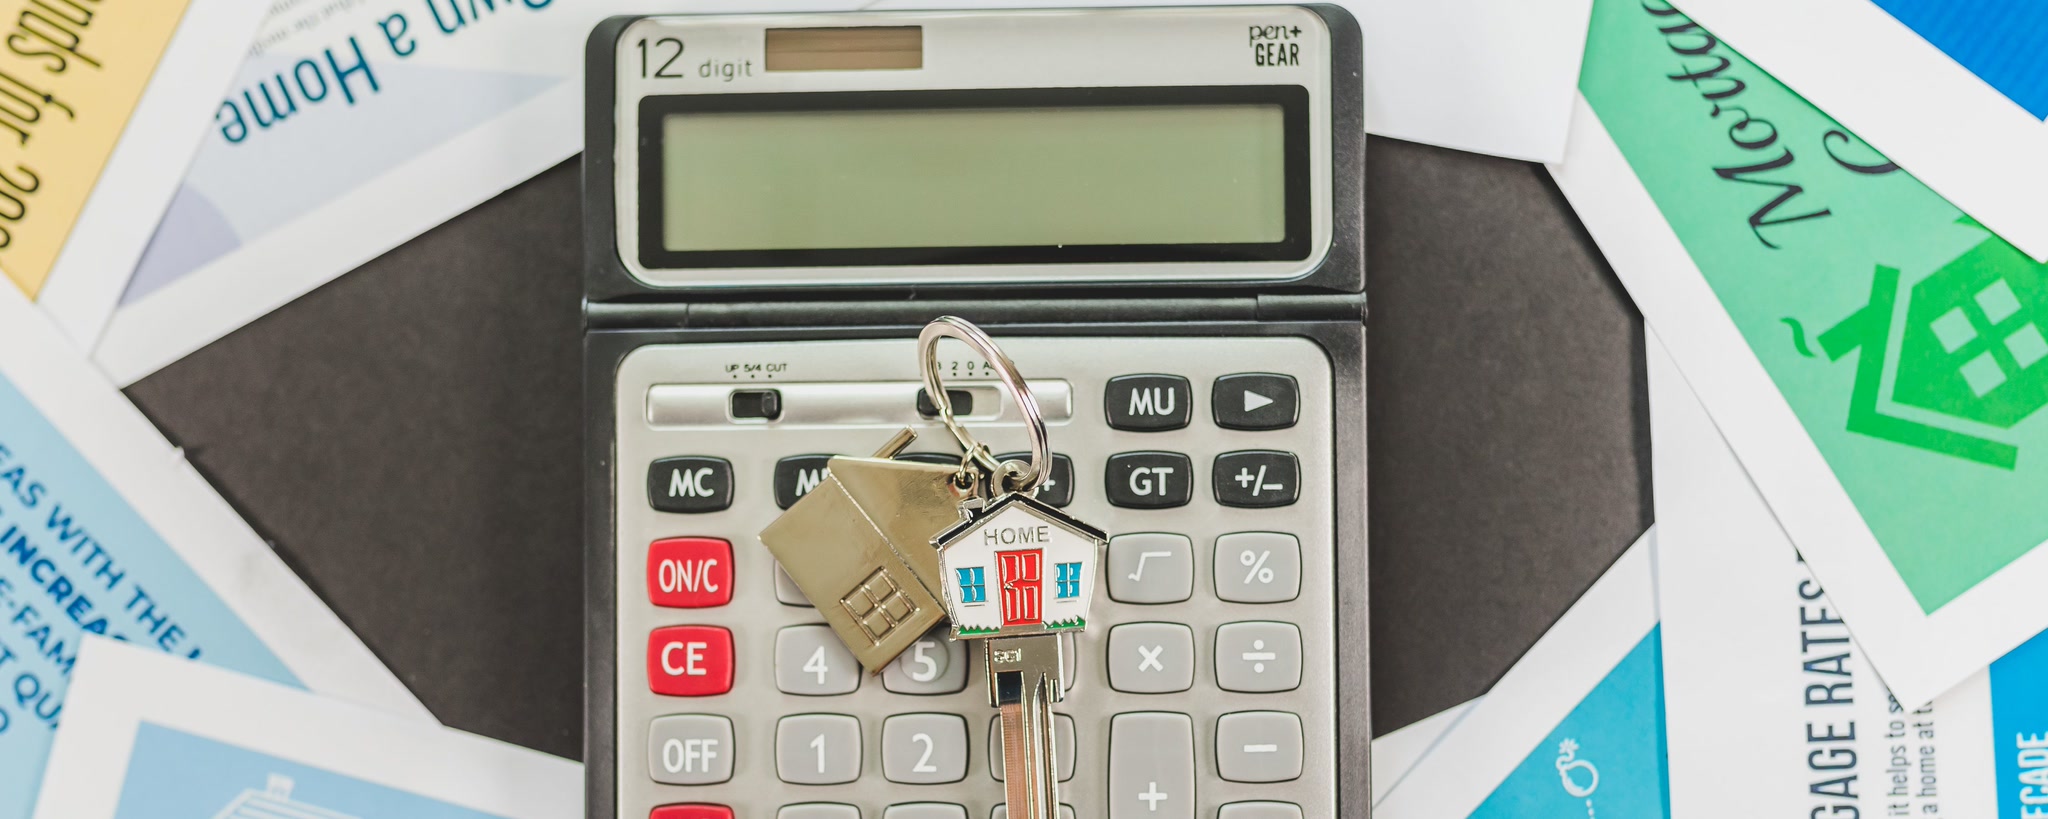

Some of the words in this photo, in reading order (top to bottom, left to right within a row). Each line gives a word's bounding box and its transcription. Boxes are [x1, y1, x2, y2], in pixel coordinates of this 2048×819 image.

[376, 13, 417, 58] a
[637, 37, 685, 79] 12
[698, 59, 753, 83] digit
[1255, 43, 1299, 67] GEAR
[215, 36, 380, 143] Home
[725, 363, 740, 373] UP
[743, 363, 762, 373] 5/4
[766, 363, 788, 373] CUT
[951, 361, 958, 371] 2
[1128, 387, 1175, 416] MU
[668, 467, 715, 498] MC
[1129, 466, 1174, 496] GT
[984, 525, 1051, 546] HOME
[0, 525, 130, 642] INCREA
[46, 505, 125, 591] WITH
[125, 584, 188, 653] THE
[658, 558, 719, 593] ON/C
[661, 641, 707, 676] CE
[802, 645, 829, 685] 4
[912, 641, 937, 682] 5
[14, 672, 63, 729] QU
[1884, 720, 1906, 739] to
[1912, 721, 1935, 739] at
[662, 737, 719, 774] OFF
[809, 733, 826, 774] 1
[911, 732, 938, 773] 2
[1885, 745, 1912, 797] helps
[1915, 746, 1937, 798] home
[1888, 803, 1910, 816] it
[1923, 803, 1939, 814] a
